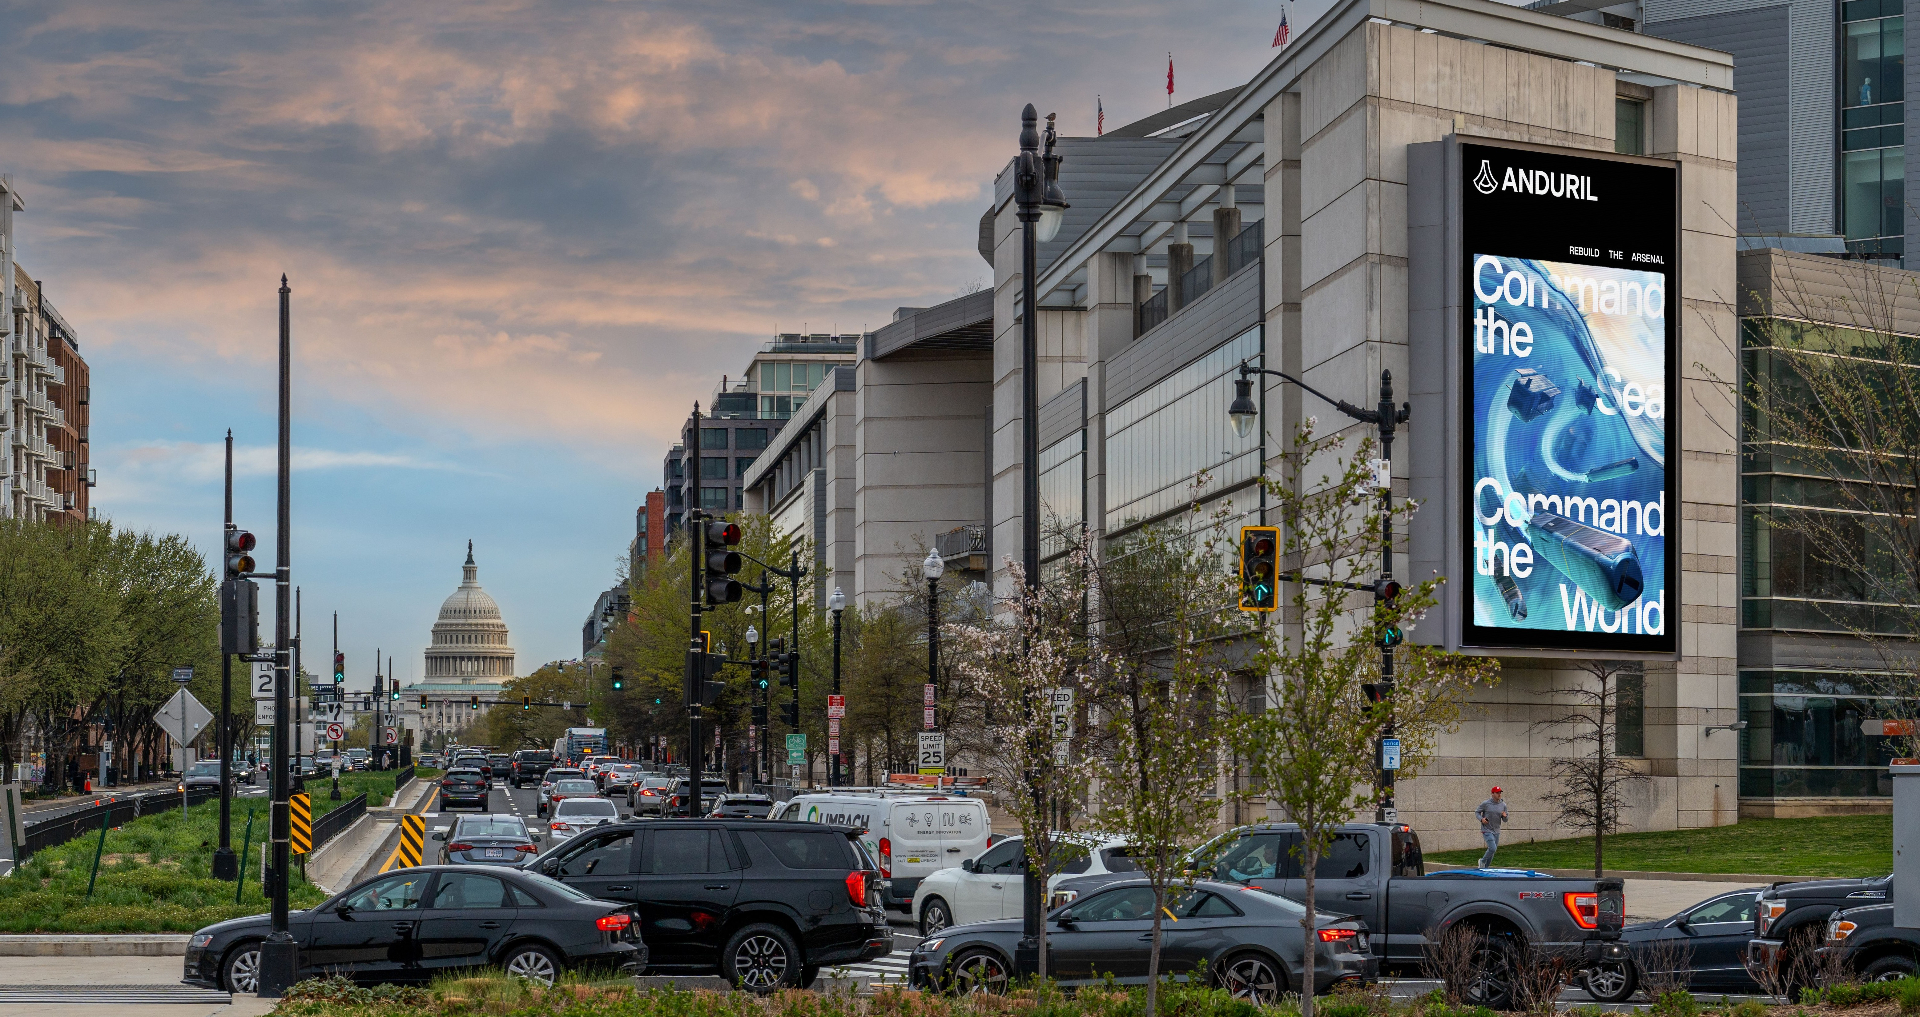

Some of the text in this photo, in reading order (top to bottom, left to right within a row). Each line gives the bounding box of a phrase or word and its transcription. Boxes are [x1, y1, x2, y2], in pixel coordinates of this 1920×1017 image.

[1502, 167, 1598, 202] ANDURIL
[1569, 245, 1665, 265] REBUILD THE ARSENAL
[1473, 254, 1665, 320] Command
[1473, 306, 1534, 358] the
[1595, 366, 1665, 419] Sea
[1473, 528, 1534, 579] the
[1044, 693, 1071, 702] PEED
[921, 751, 942, 764] 25
[819, 812, 870, 829] LIMBACH
